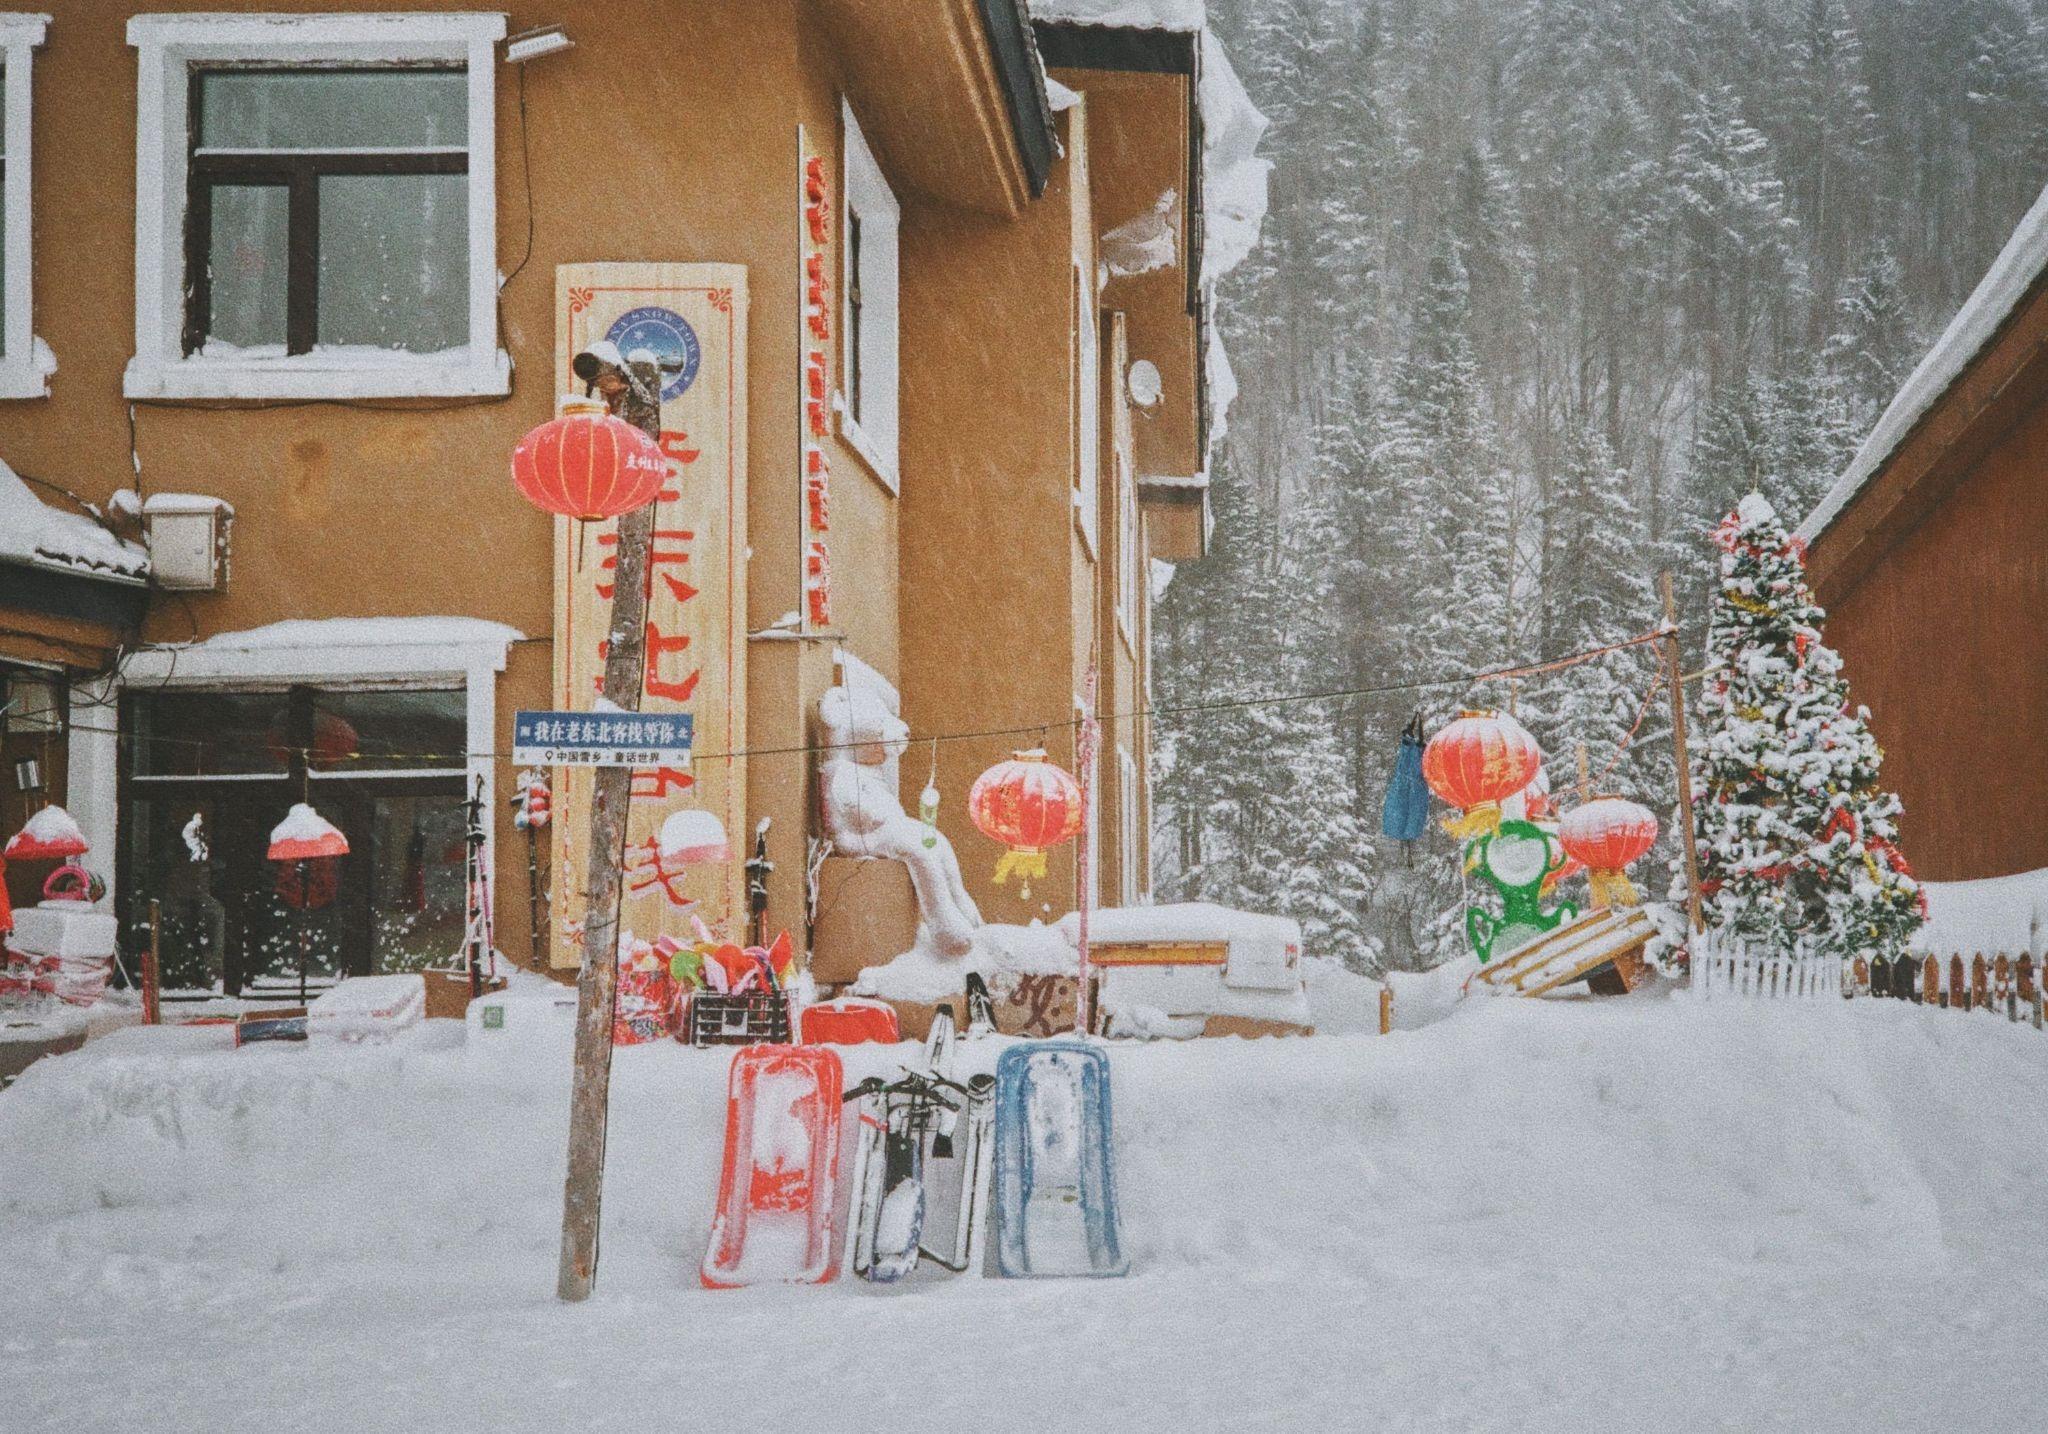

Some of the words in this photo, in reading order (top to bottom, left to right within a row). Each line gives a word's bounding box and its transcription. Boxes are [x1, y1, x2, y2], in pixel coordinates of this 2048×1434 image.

[534, 720, 674, 744] 我在老东北客栈等你
